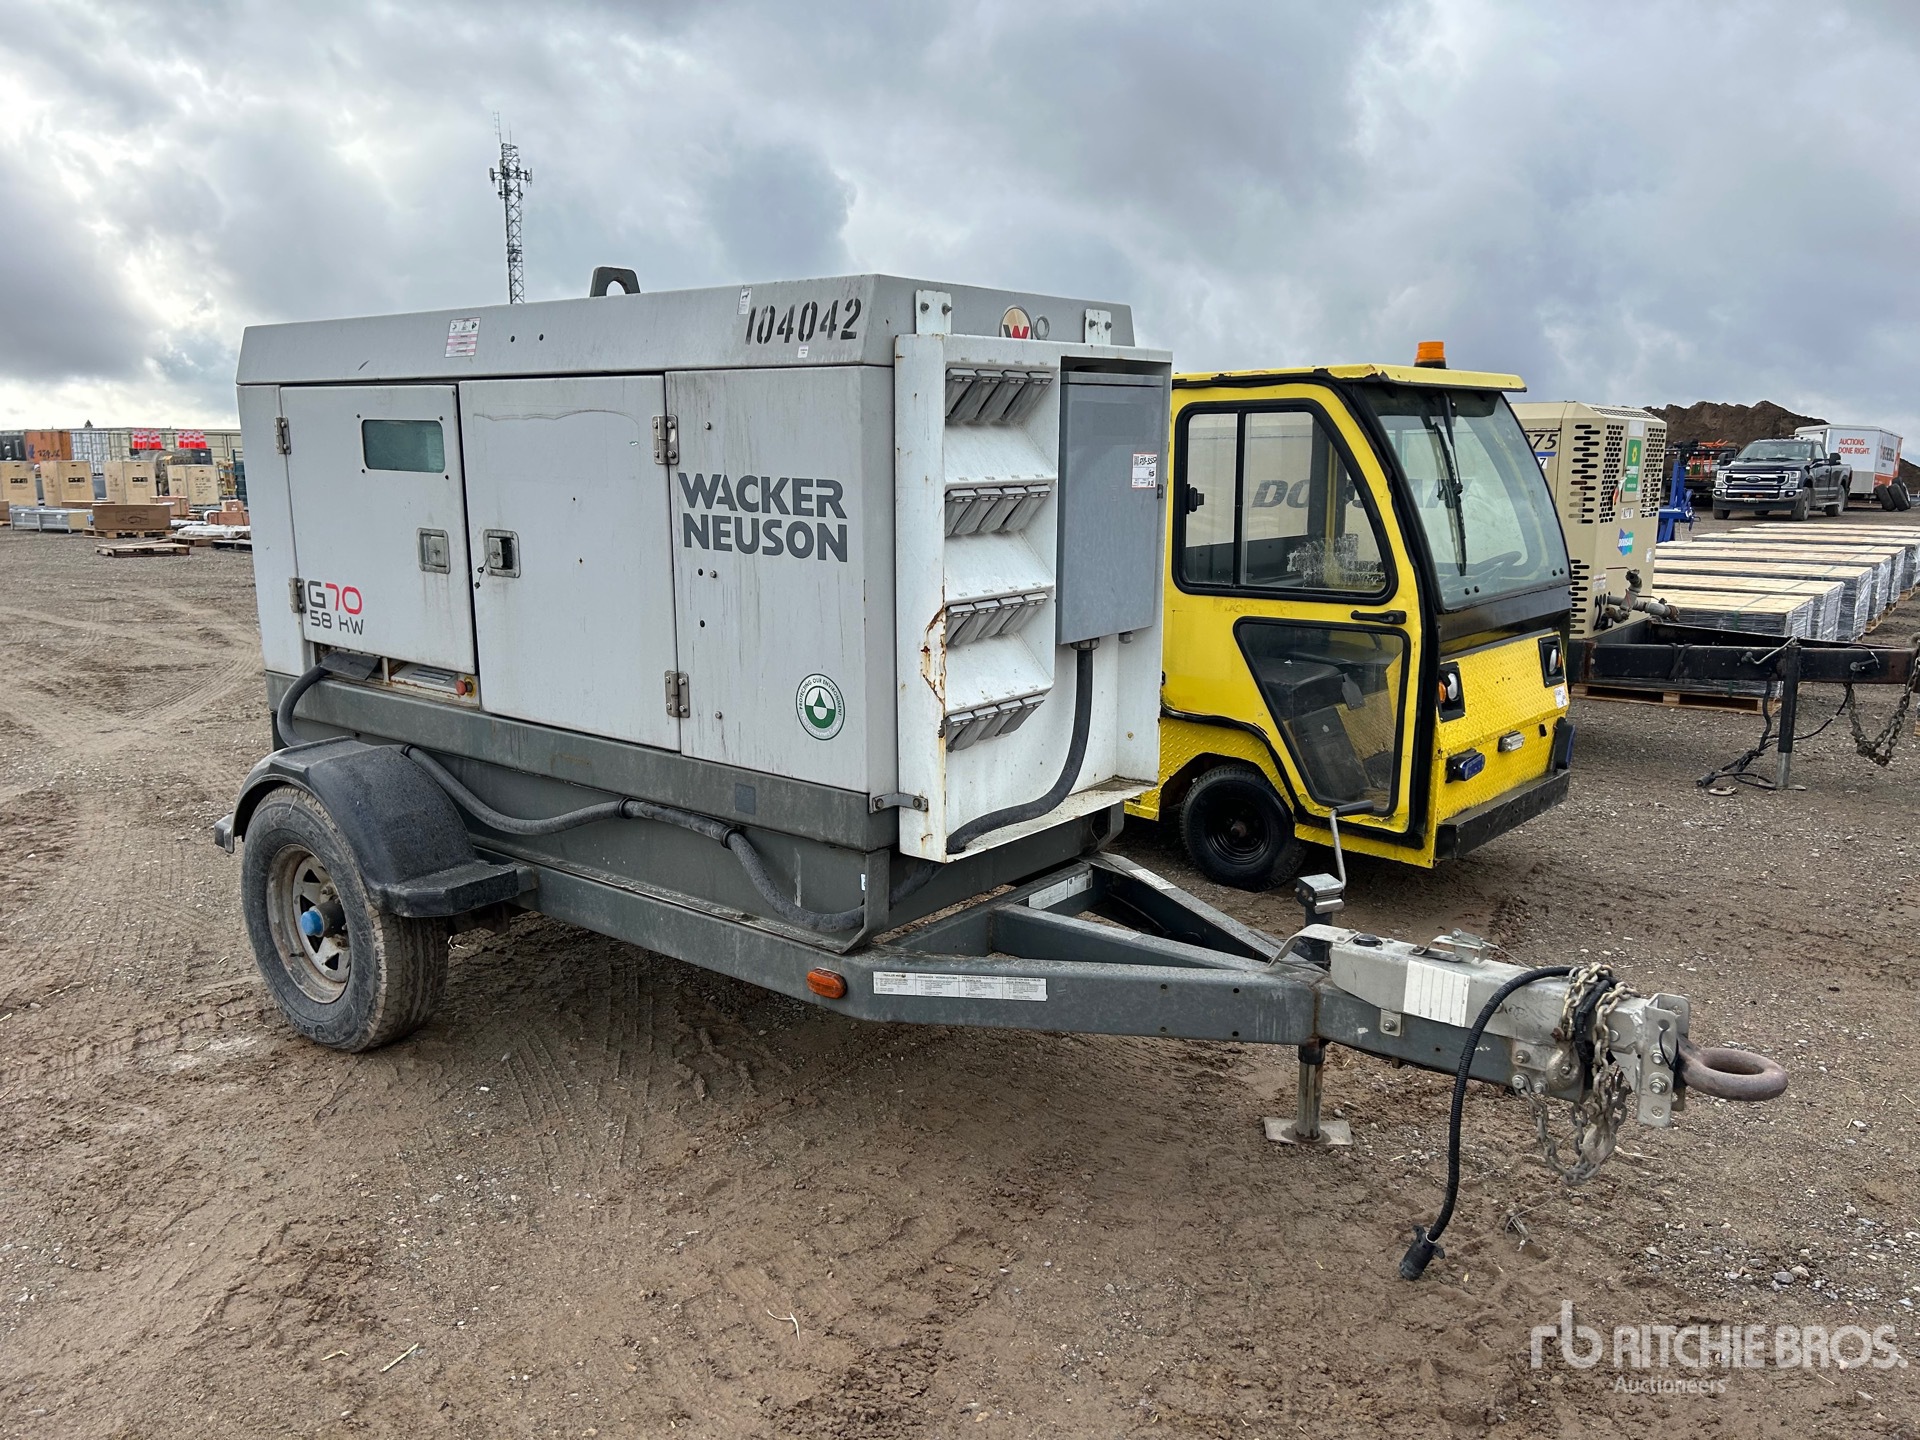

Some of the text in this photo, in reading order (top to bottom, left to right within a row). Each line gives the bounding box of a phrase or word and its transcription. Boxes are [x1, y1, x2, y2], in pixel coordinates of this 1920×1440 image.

[745, 298, 862, 345] 104042
[1526, 434, 1558, 450] 75
[677, 472, 848, 520] WACKER
[683, 512, 848, 562] NEUSON
[308, 581, 362, 615] G70
[310, 610, 332, 629] 58
[798, 680, 812, 709] PROTECTING
[822, 679, 842, 716] ENVIRONMENT
